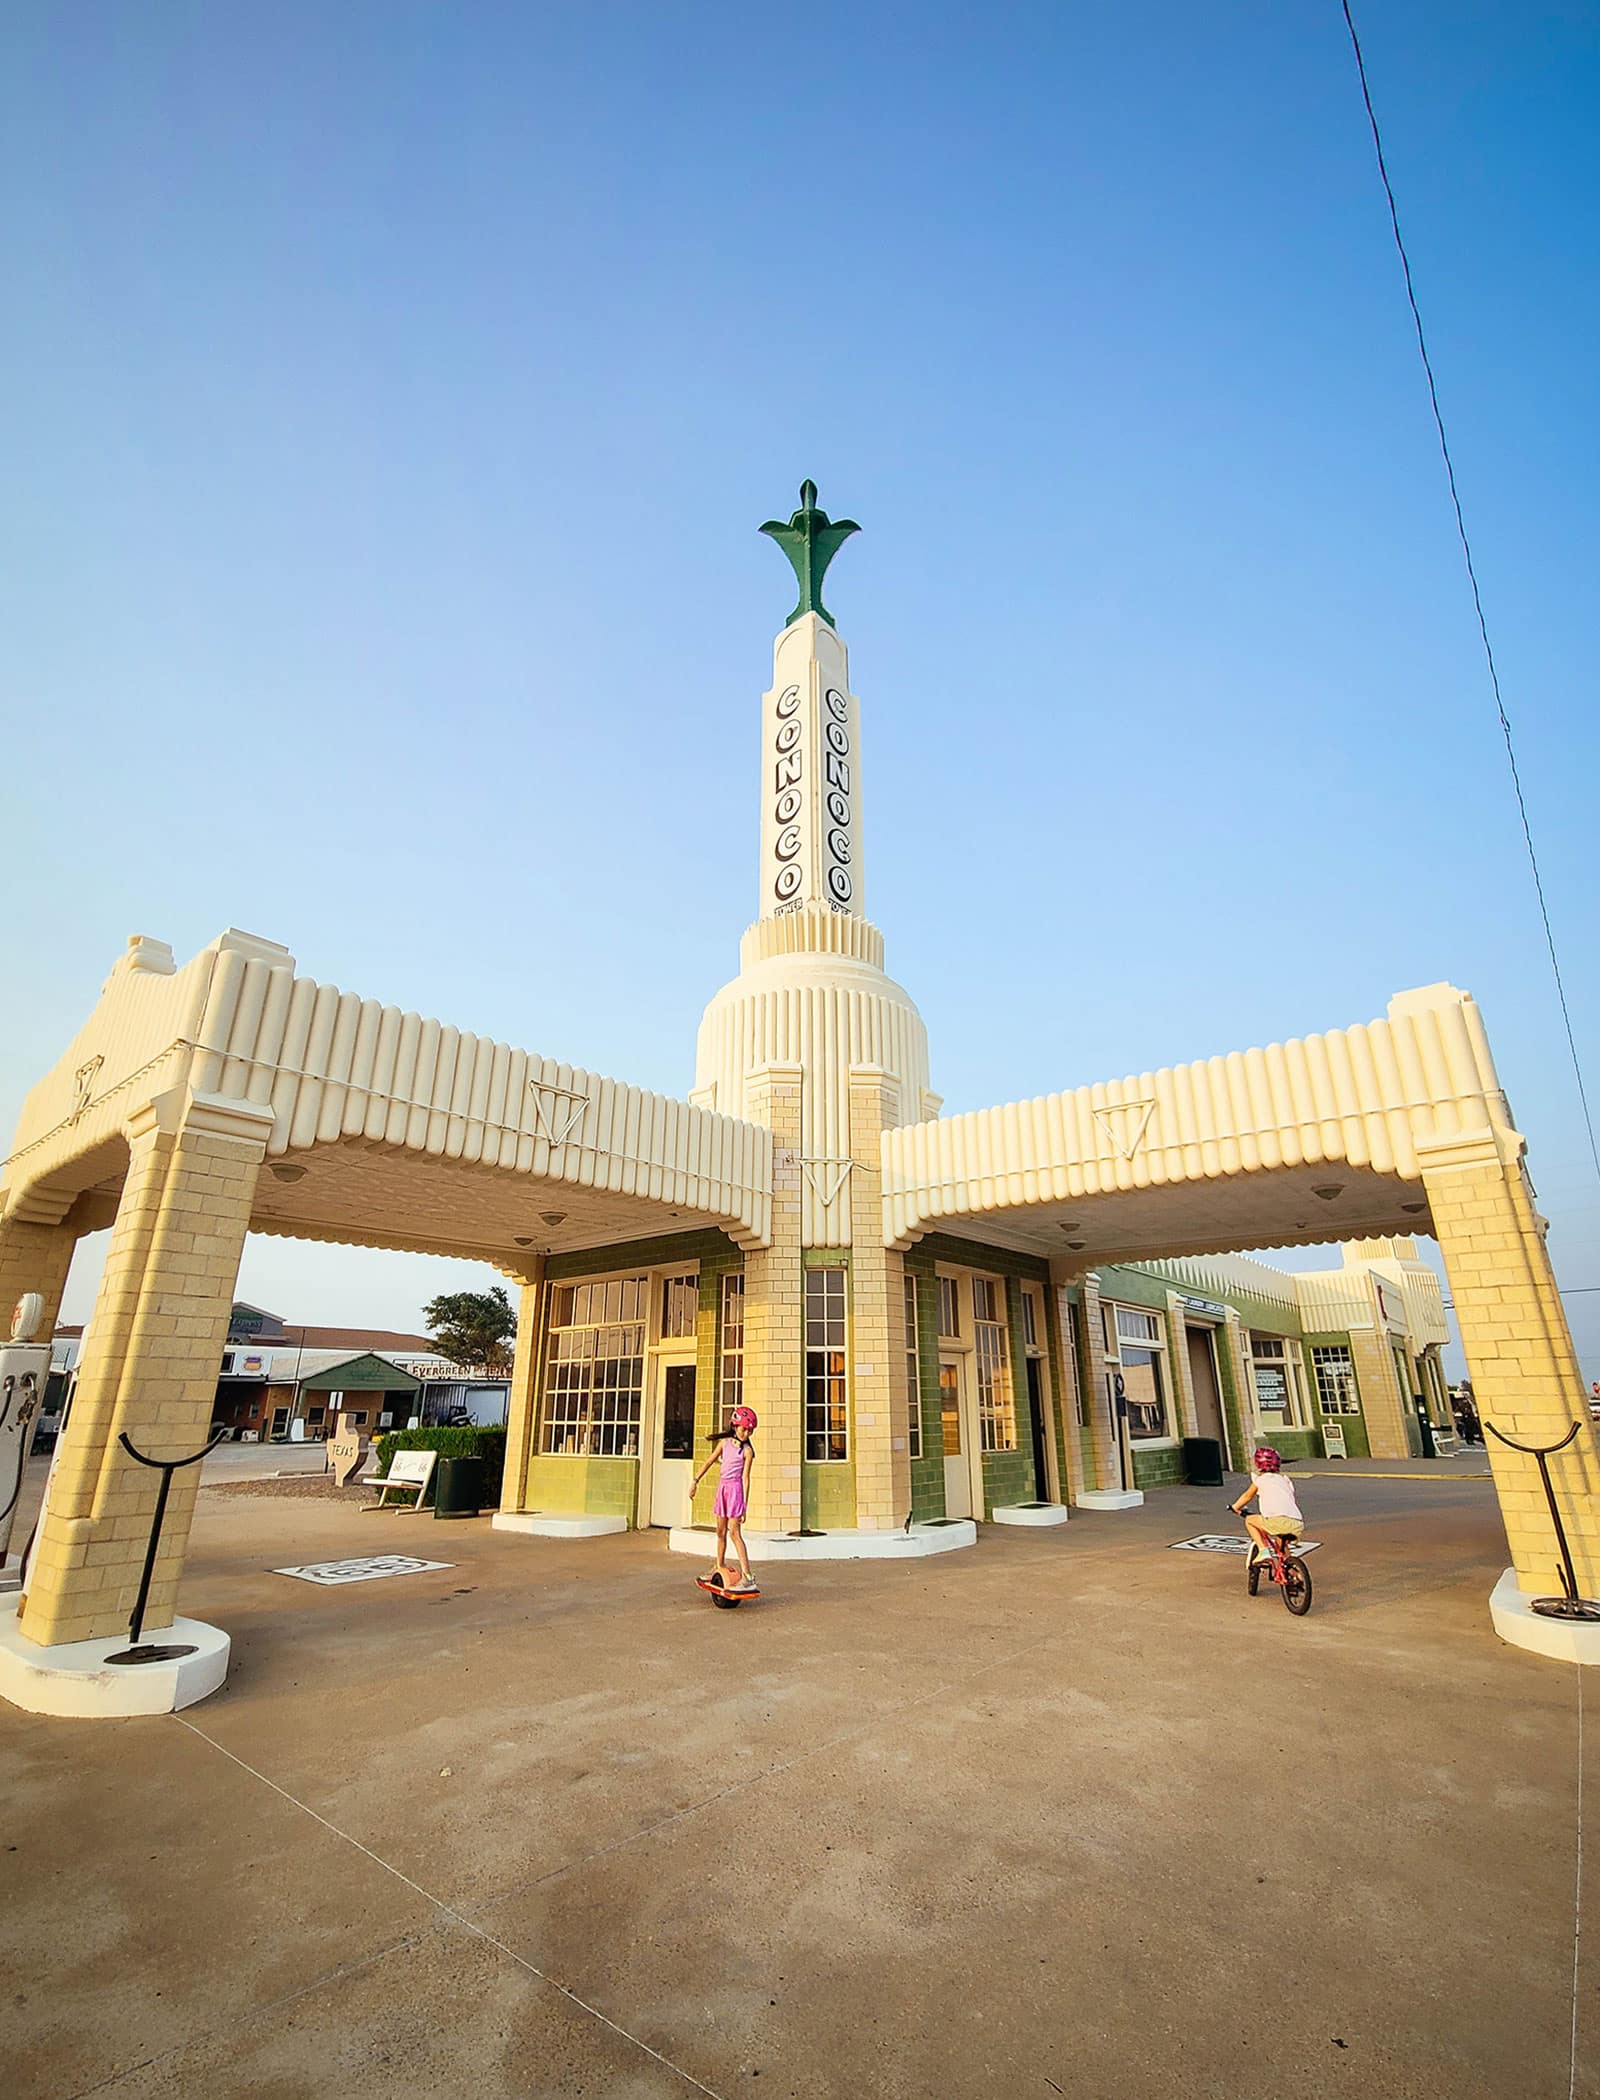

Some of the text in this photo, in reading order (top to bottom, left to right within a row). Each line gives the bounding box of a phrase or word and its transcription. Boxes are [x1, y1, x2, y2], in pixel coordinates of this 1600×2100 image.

[775, 684, 803, 901] CONOCO
[826, 688, 852, 902] CONOCO
[412, 1365, 470, 1378] EVERGREEN
[332, 1444, 354, 1458] TEXAS
